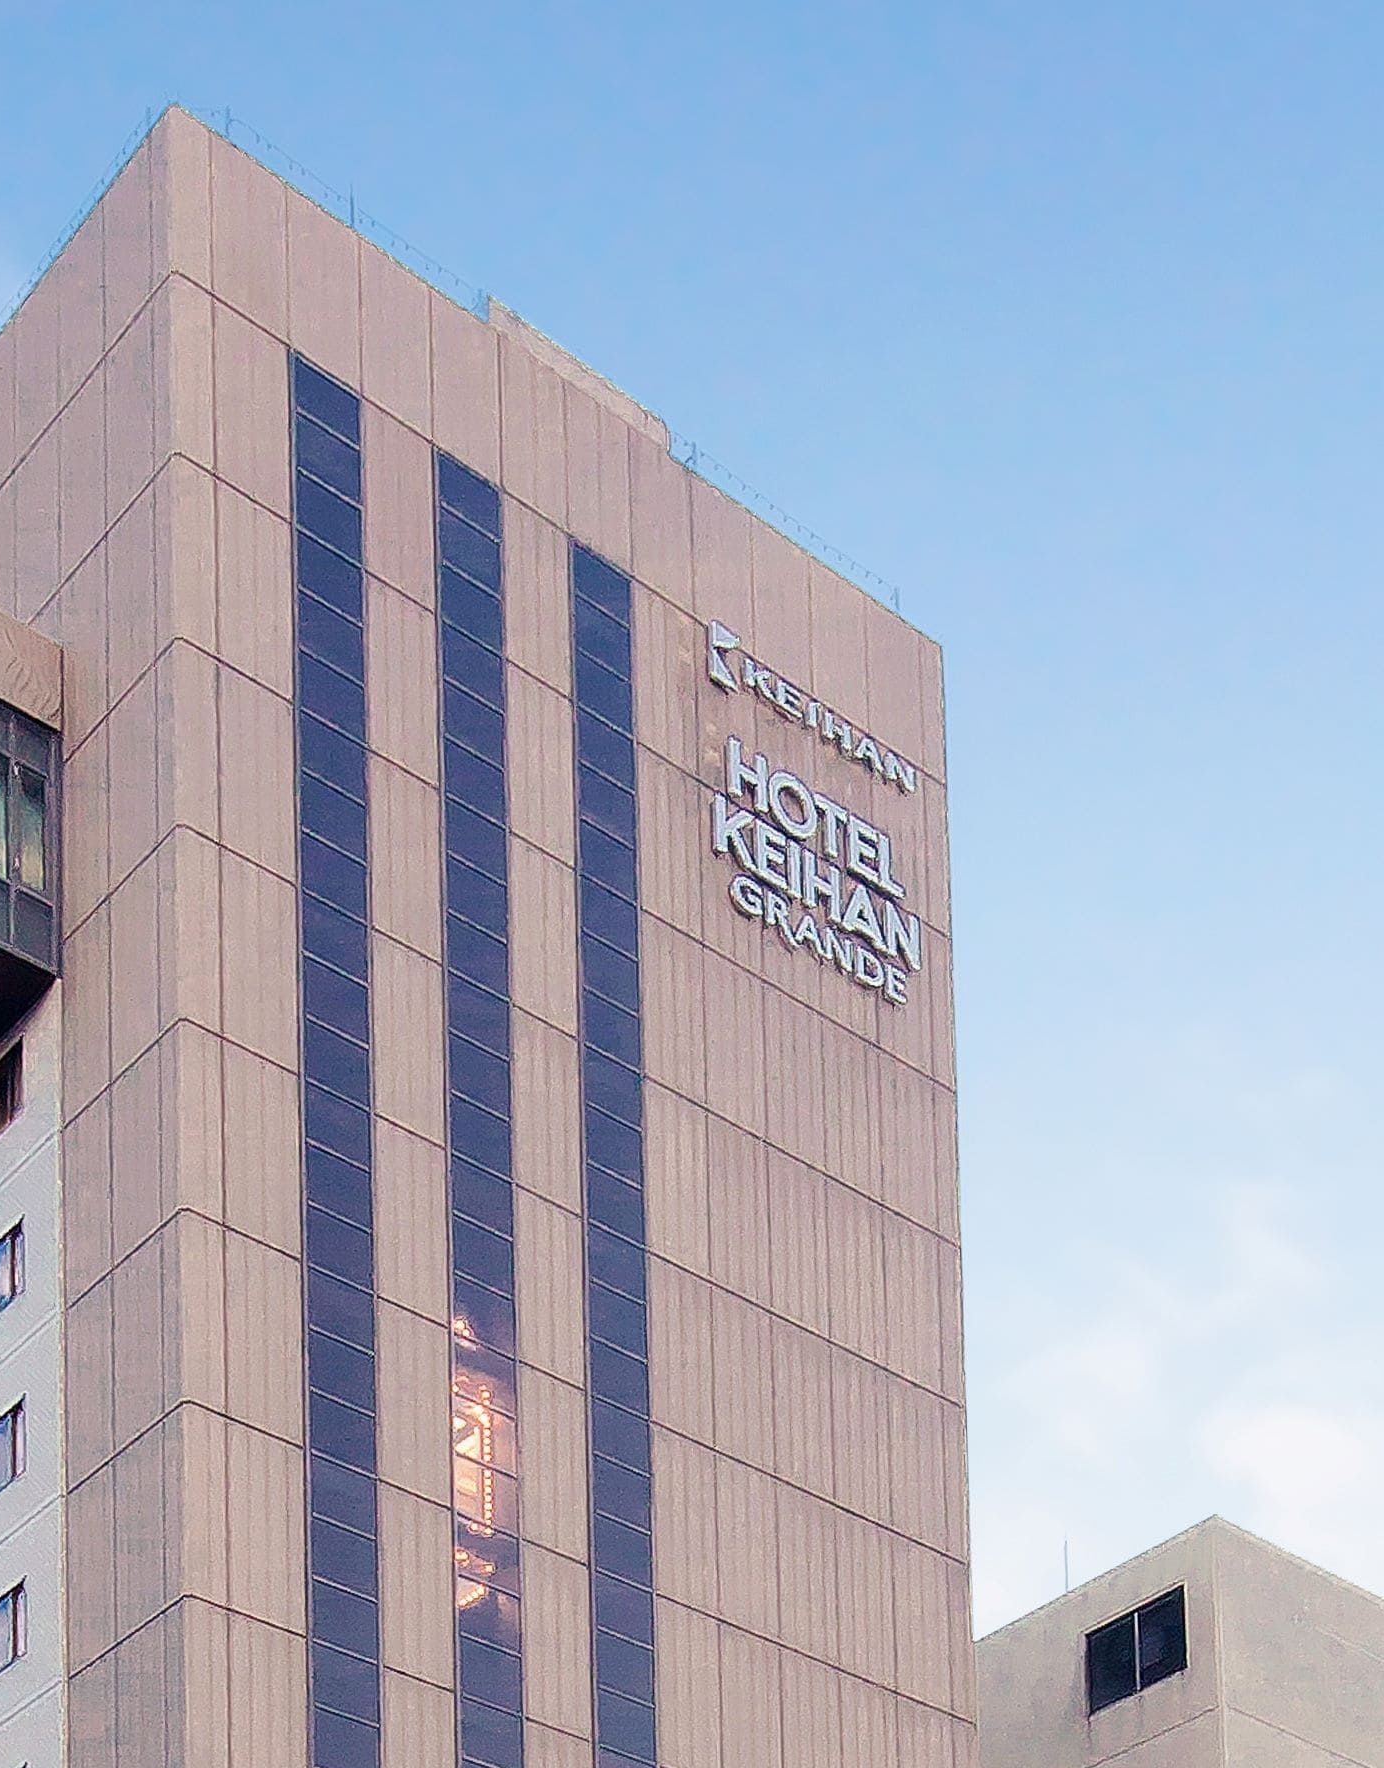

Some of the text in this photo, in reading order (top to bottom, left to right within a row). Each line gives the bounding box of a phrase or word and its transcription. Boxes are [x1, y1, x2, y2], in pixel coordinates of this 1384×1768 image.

[741, 657, 916, 791] KEIHAN
[712, 791, 921, 971] KEIHAN
[727, 734, 906, 899] HOTEL
[729, 874, 907, 1005] GRANDE
